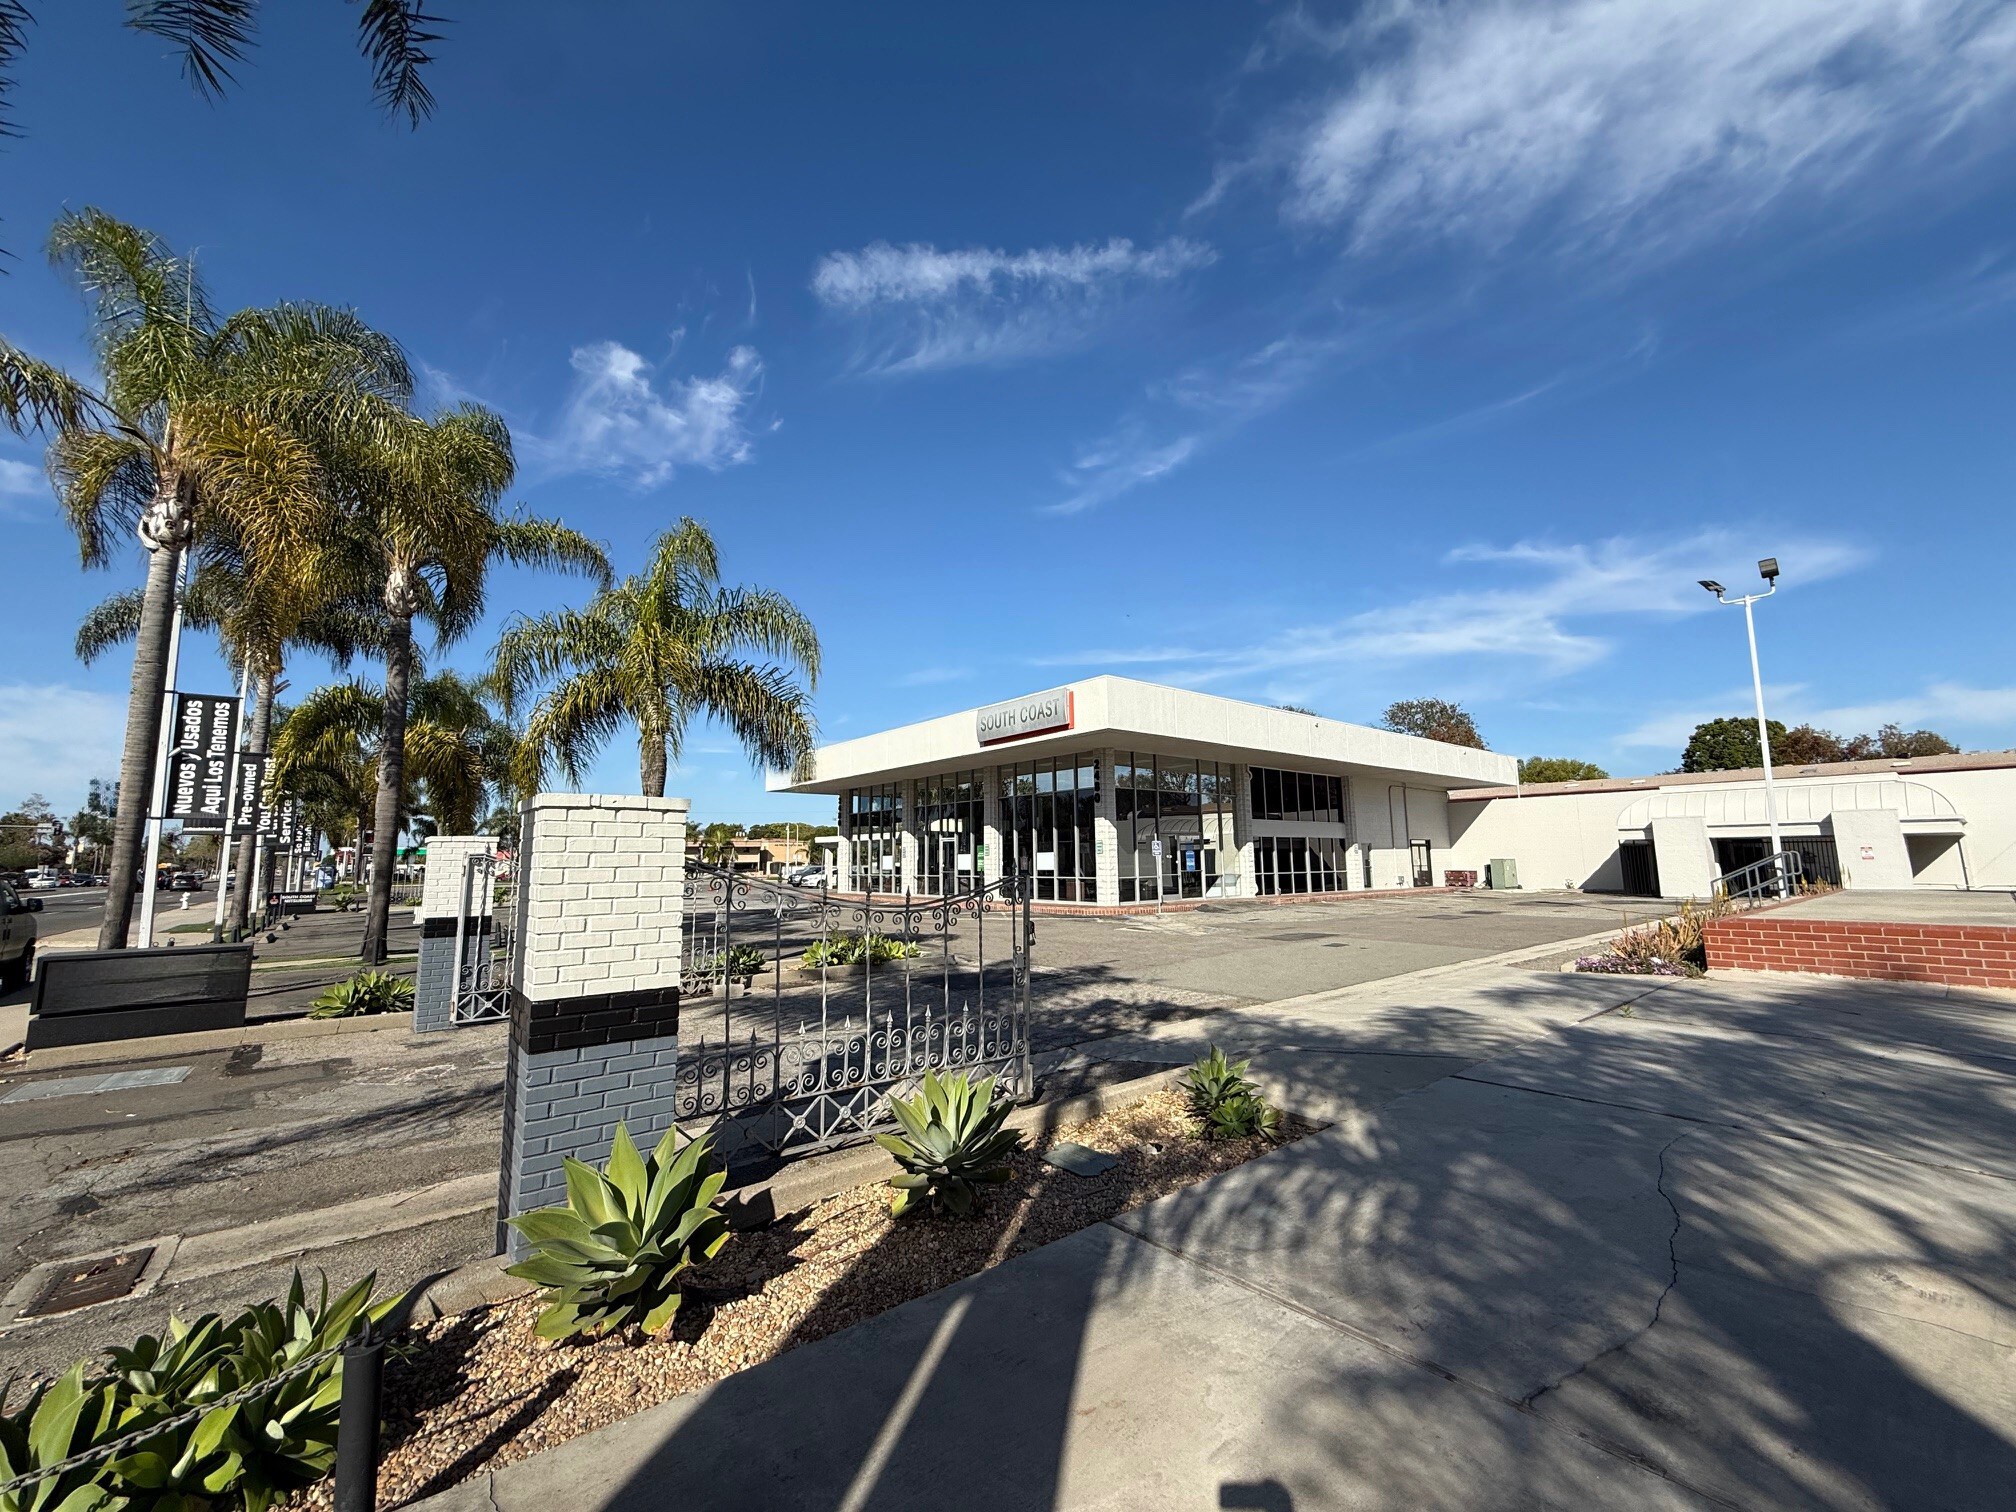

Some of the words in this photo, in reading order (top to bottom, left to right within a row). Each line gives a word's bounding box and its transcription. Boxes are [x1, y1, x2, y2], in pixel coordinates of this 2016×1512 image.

[180, 700, 203, 750] Usados
[206, 702, 230, 758] Tenemos
[980, 709, 1015, 731] SOUTH
[1020, 699, 1059, 723] COAST
[182, 752, 202, 761] y
[204, 761, 224, 782] Los
[173, 763, 196, 814] Nuevos
[201, 785, 225, 814] Aqui
[238, 764, 257, 825] Pre-owned
[257, 812, 271, 832] You
[280, 799, 292, 843] Service
